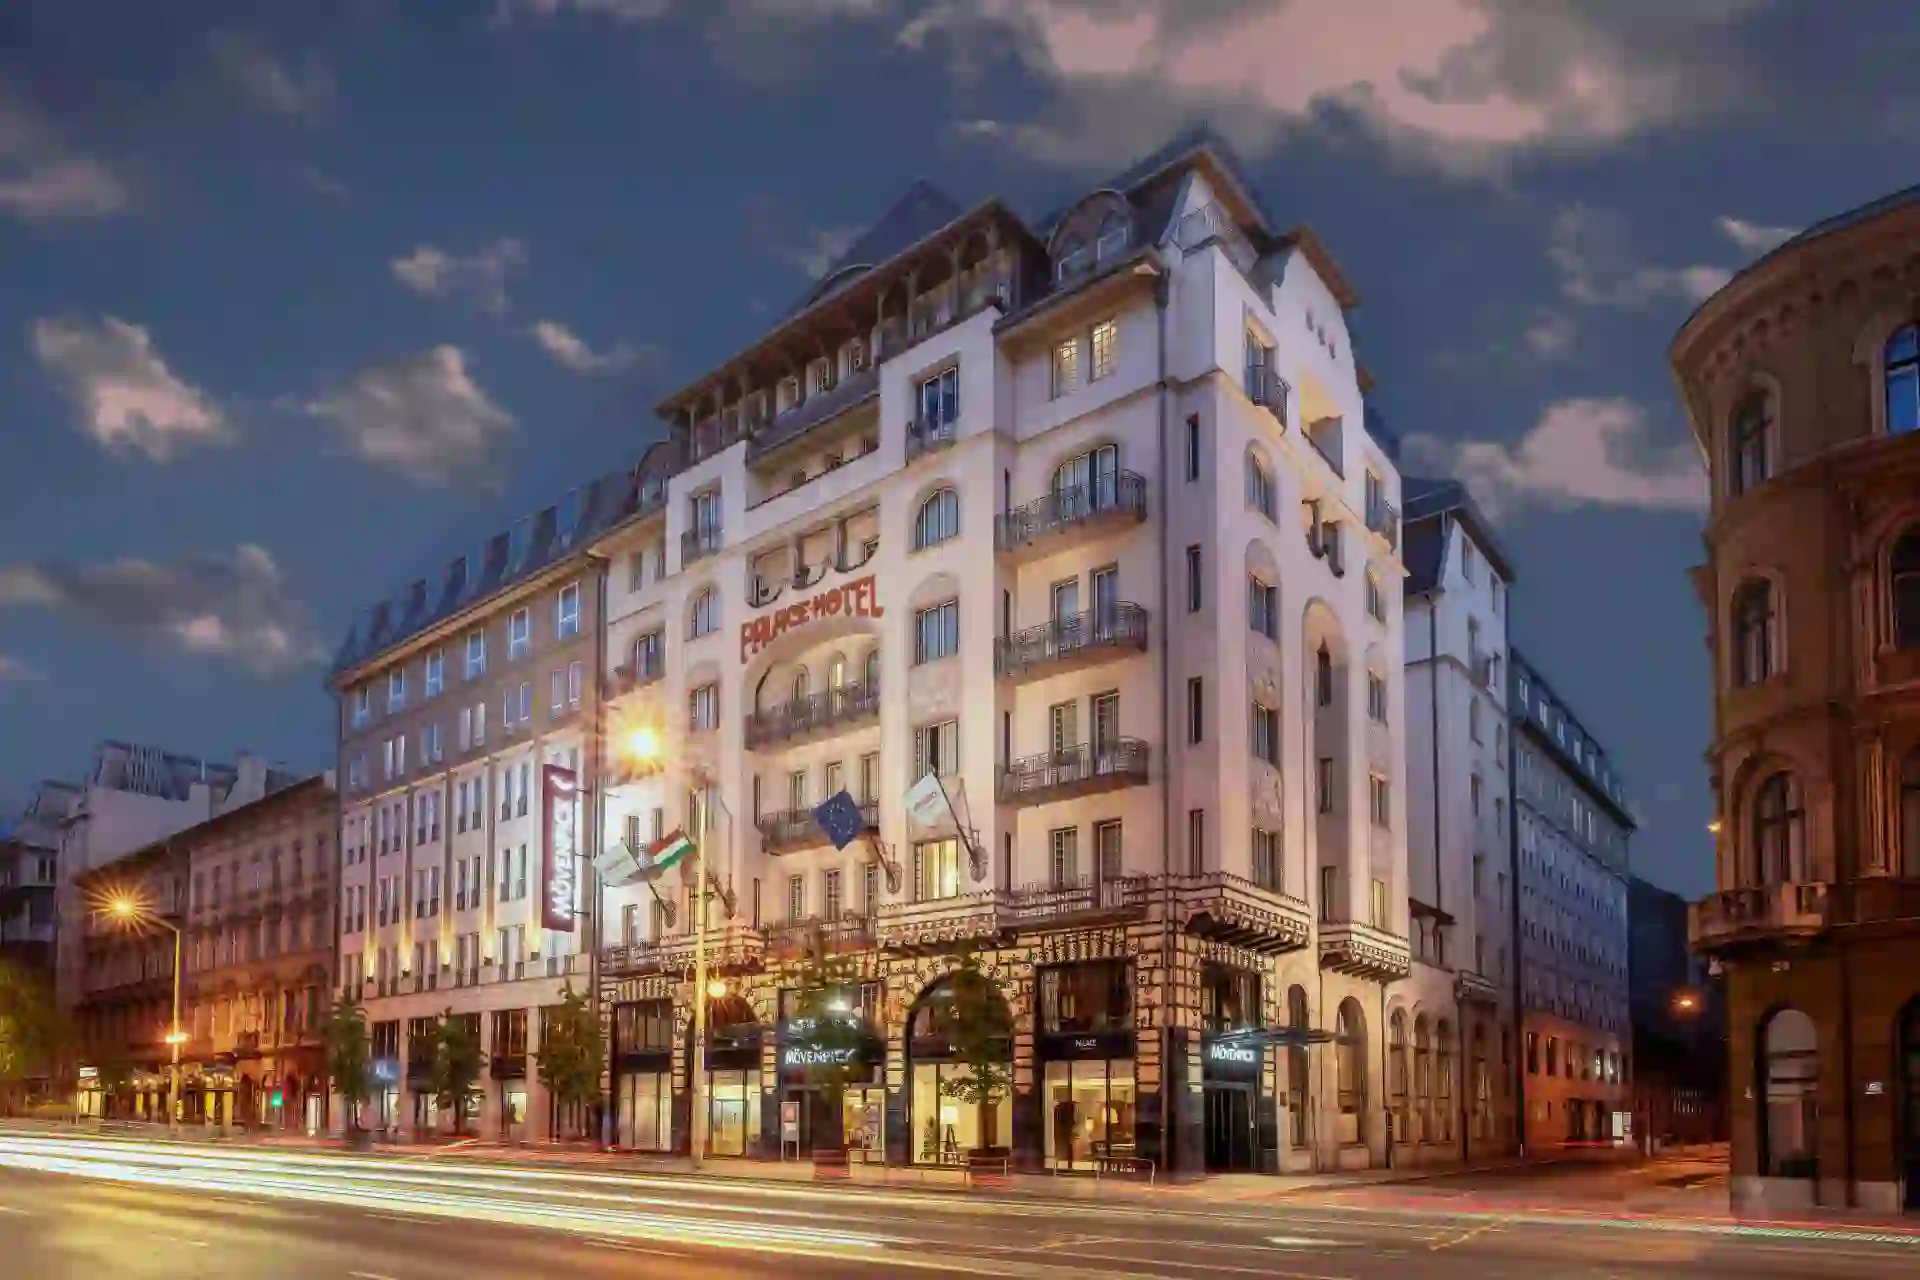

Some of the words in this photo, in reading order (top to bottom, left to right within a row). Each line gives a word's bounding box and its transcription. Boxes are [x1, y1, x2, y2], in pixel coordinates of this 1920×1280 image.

[813, 574, 884, 621] HOTEL
[548, 797, 573, 920] MÖVENC
[1211, 1044, 1256, 1063] MÖVENC
